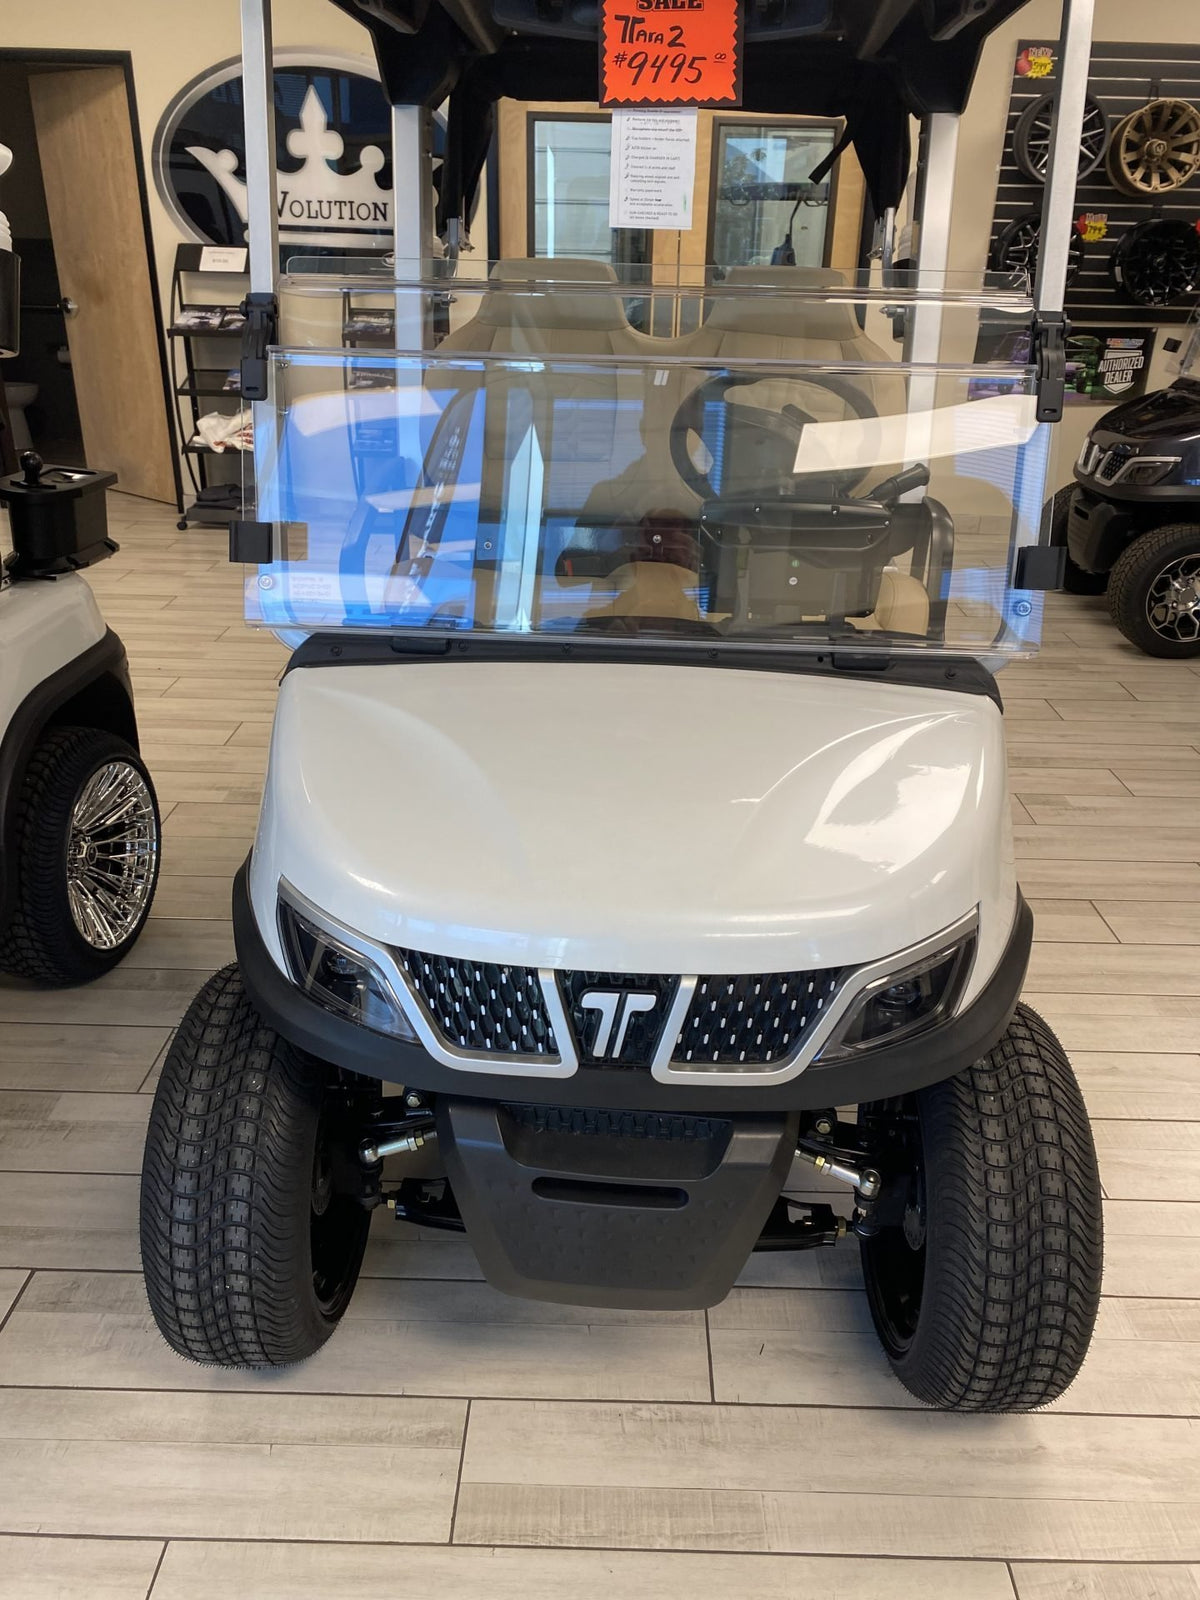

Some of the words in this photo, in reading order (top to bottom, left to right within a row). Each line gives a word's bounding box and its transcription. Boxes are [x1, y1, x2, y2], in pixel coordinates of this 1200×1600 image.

[667, 25, 686, 48] 2
[277, 191, 389, 221] VOLUTION
[1098, 356, 1145, 373] AUTHORIZED
[1104, 370, 1134, 385] DEALER
